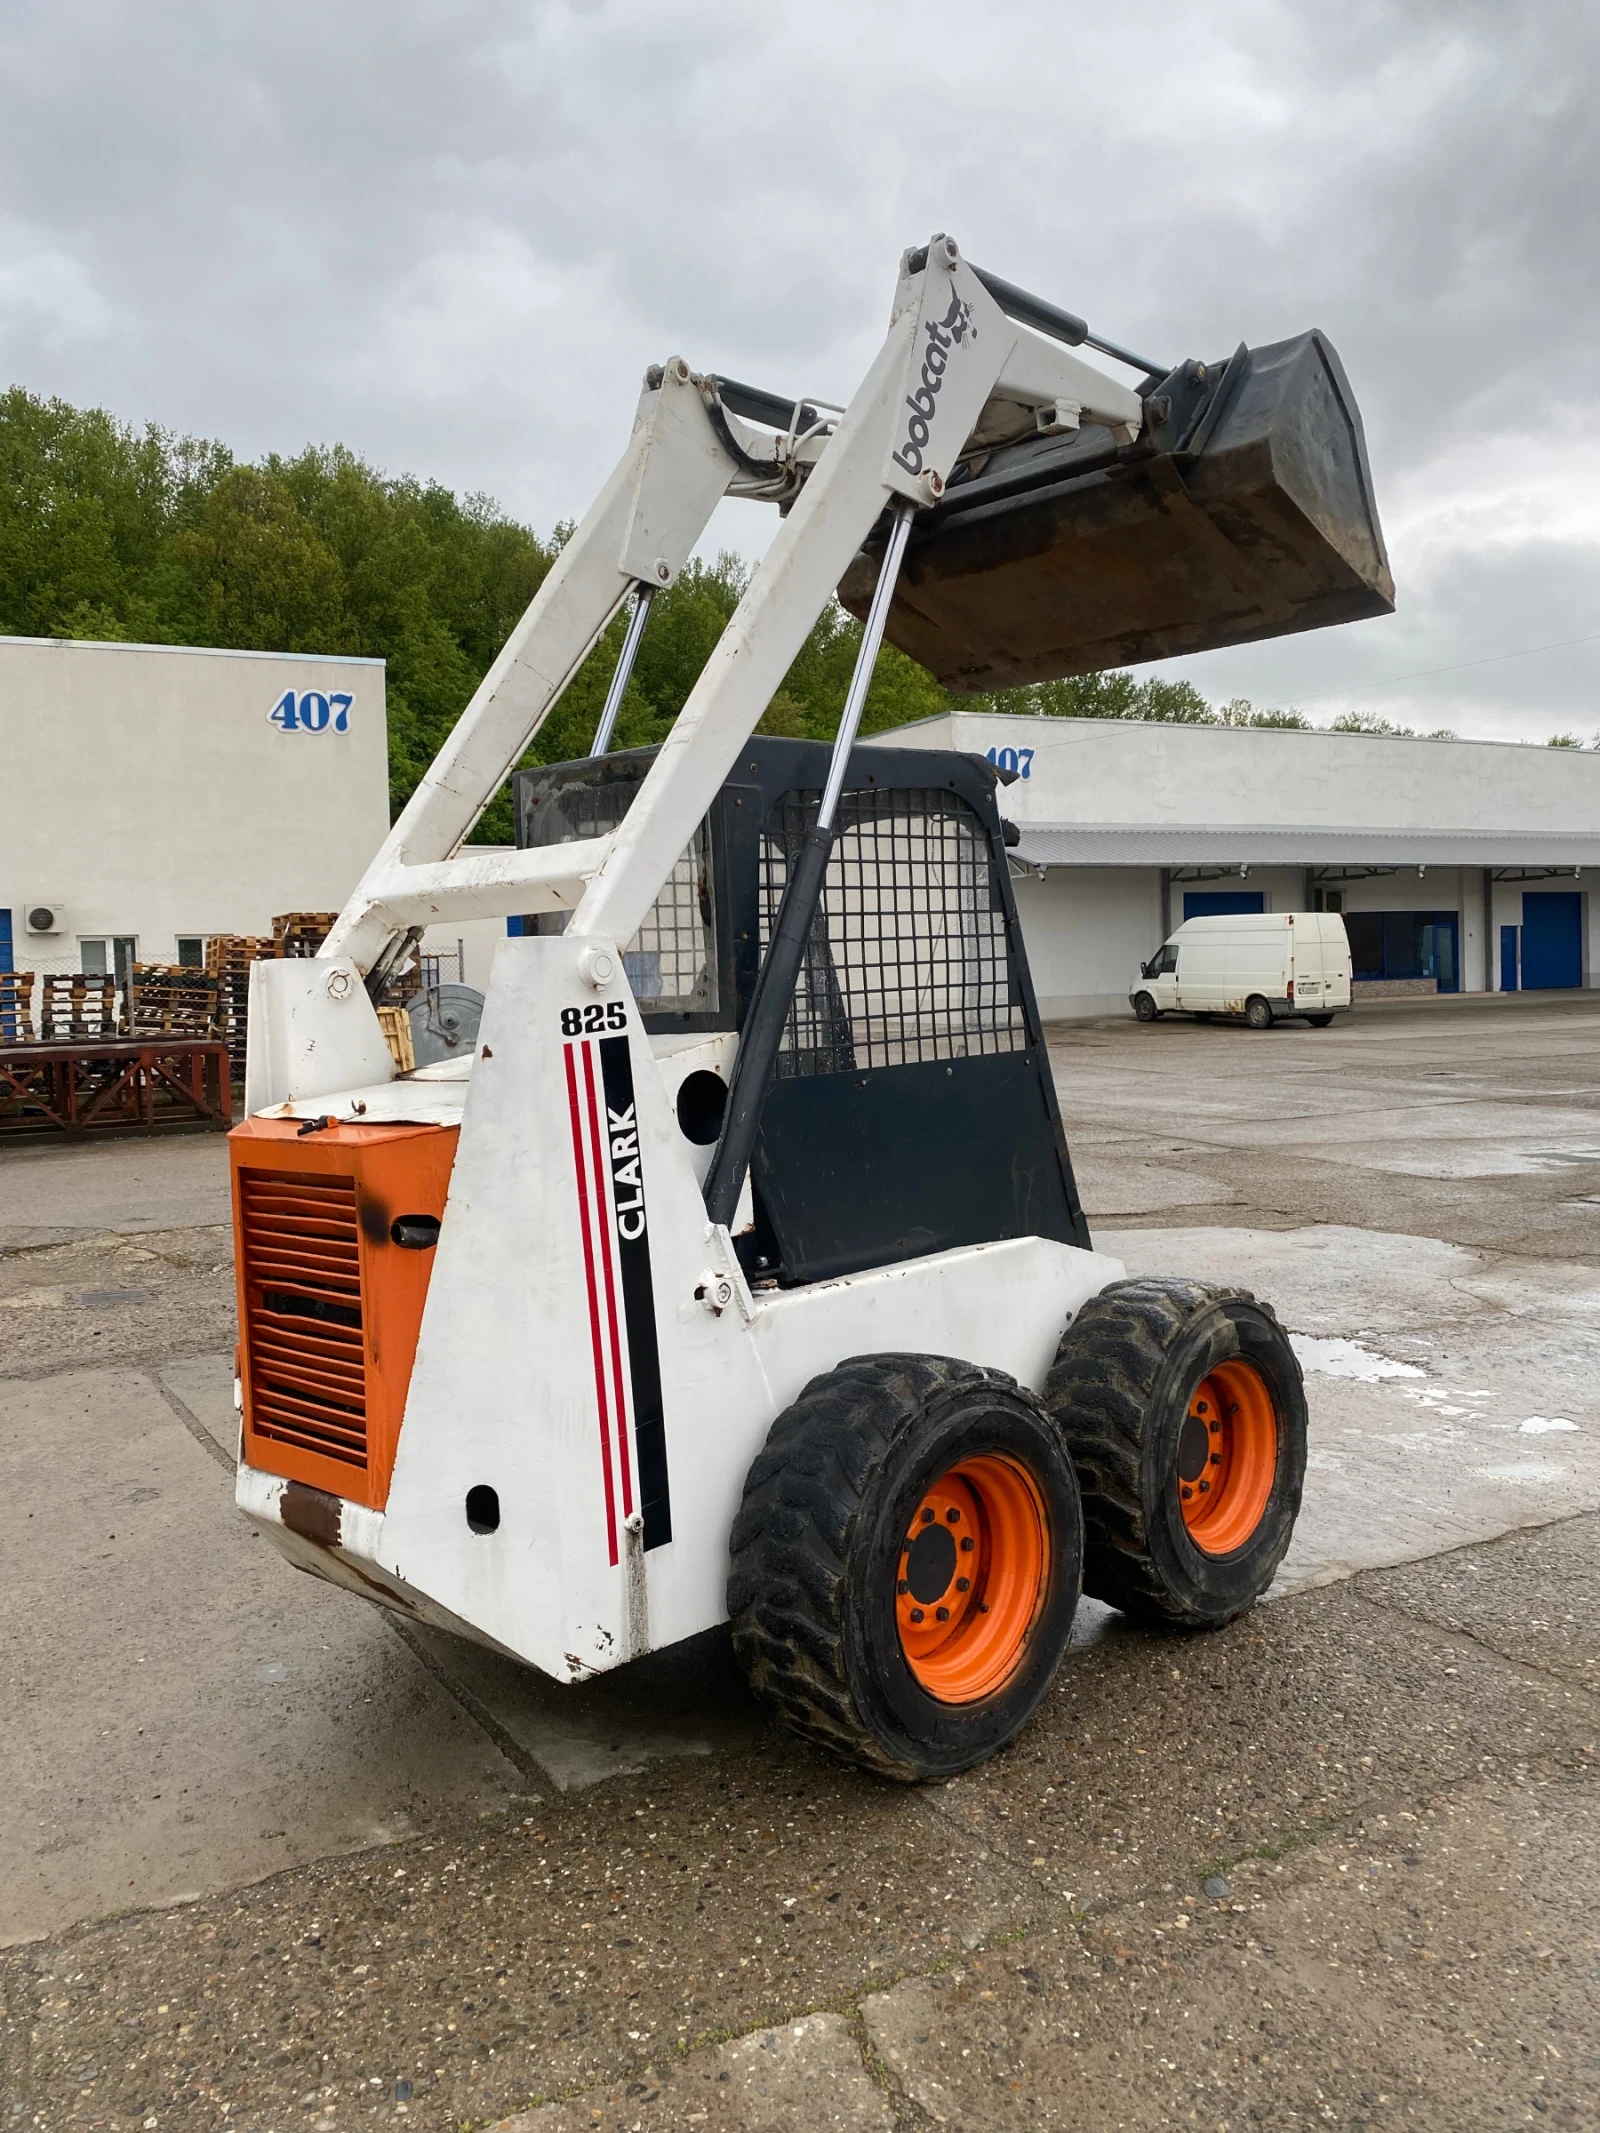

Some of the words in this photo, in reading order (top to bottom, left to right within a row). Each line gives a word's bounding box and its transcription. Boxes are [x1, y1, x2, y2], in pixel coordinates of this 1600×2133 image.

[892, 320, 952, 476] bobcat
[270, 691, 353, 731] 407
[560, 1001, 628, 1037] 825
[608, 1102, 646, 1240] CLARK
